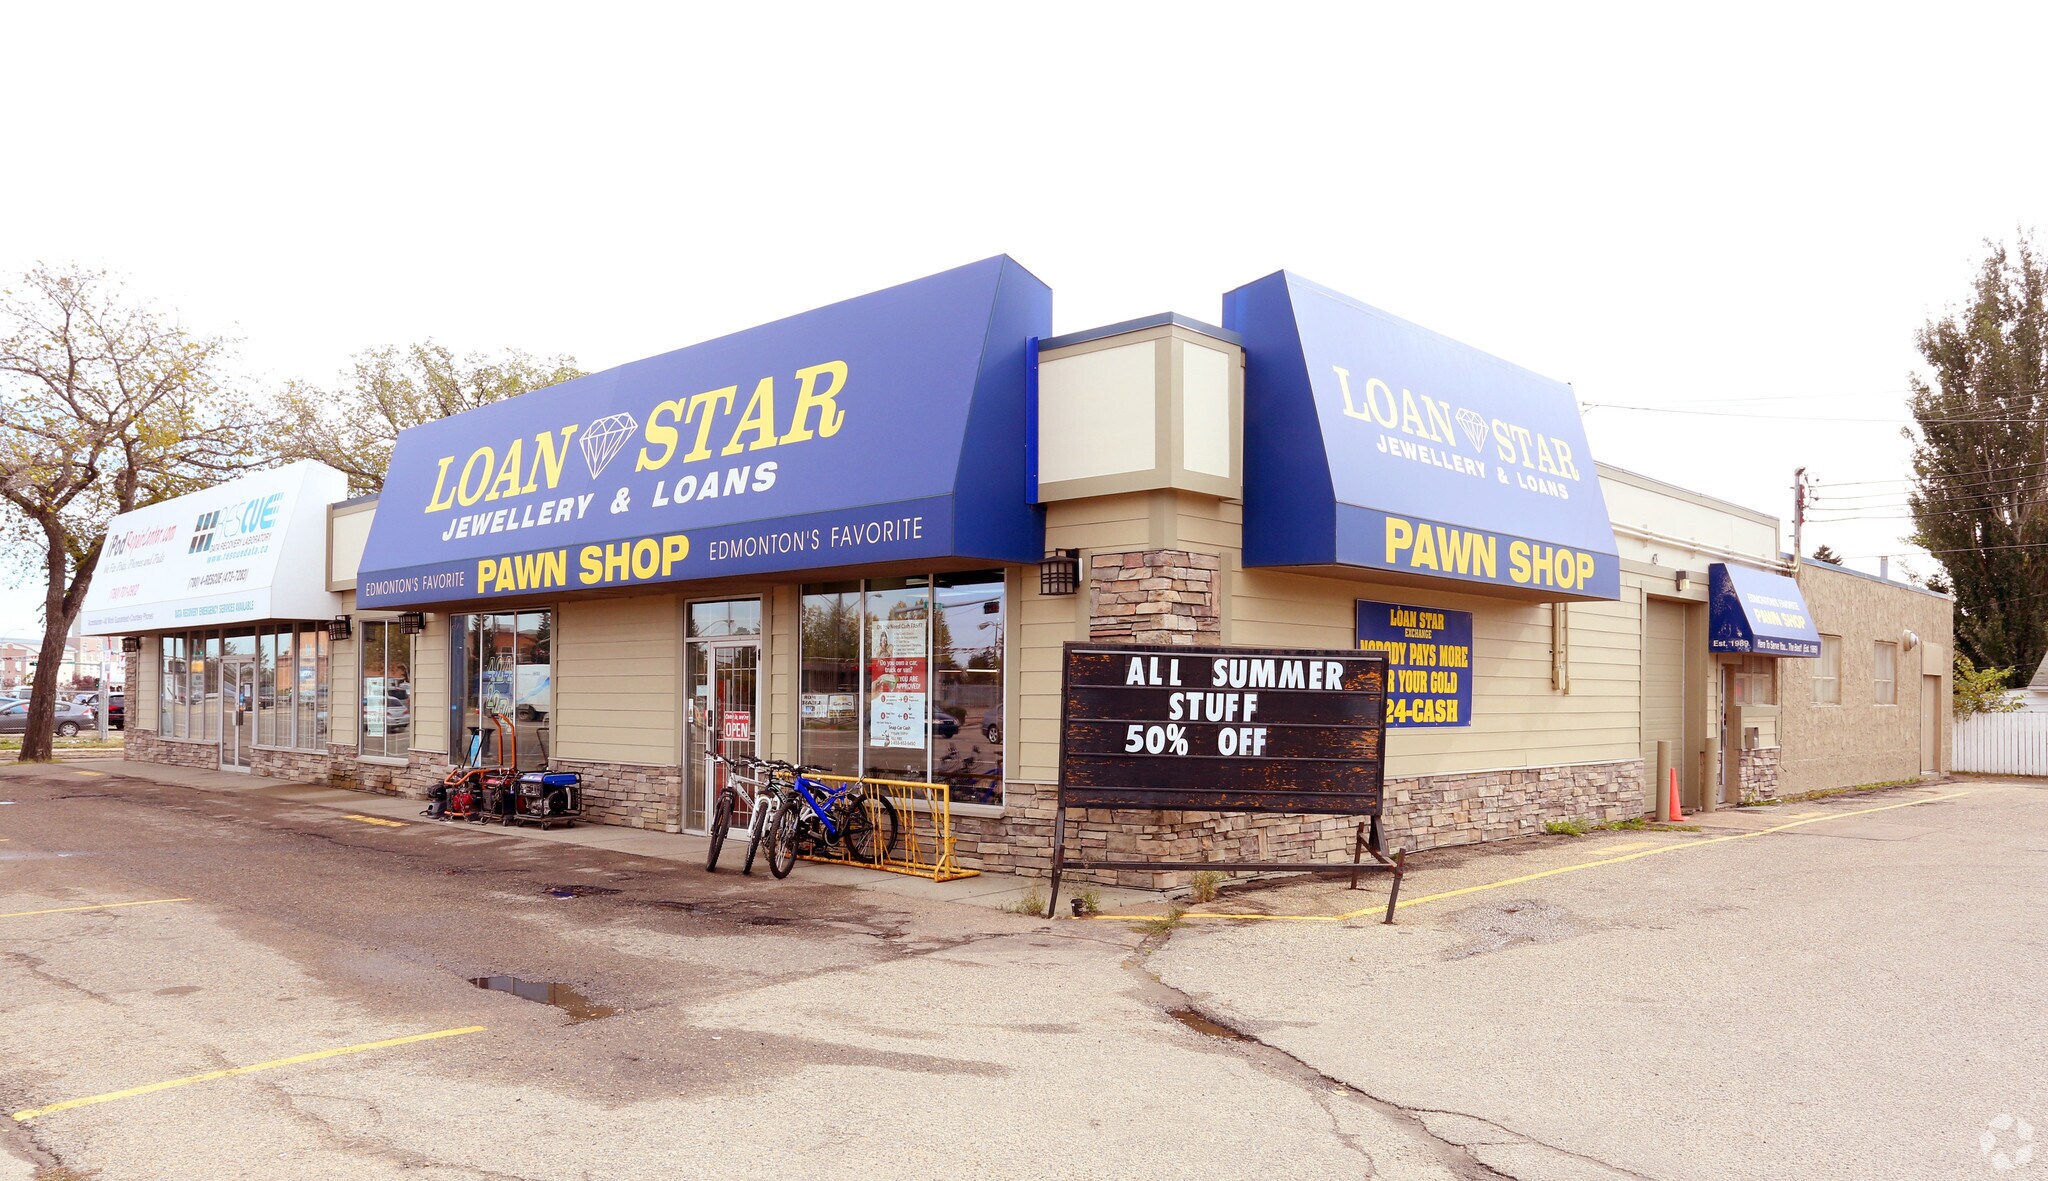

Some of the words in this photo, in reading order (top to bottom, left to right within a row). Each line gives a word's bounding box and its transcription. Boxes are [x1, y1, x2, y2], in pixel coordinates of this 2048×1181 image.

[424, 423, 579, 514] LOAN
[634, 360, 849, 472] STAR
[1332, 364, 1457, 447] LOAN
[1491, 418, 1581, 482] STAR
[1376, 433, 1486, 479] JEWELLERY
[1496, 466, 1510, 485] &
[1516, 471, 1569, 500] LOANS
[441, 492, 595, 541] JEWELLERY
[610, 486, 631, 514] &
[651, 461, 778, 508] LOANS
[708, 528, 820, 561] EDMONTON'S
[831, 516, 923, 548] FAVORITE
[1385, 516, 1497, 578] PAWN
[1509, 540, 1595, 591] SHOP
[477, 549, 567, 594] PAWN
[578, 534, 690, 586] SHOP
[365, 576, 419, 597] EDMONTON'S
[422, 571, 465, 590] FAVORITE
[1390, 608, 1417, 627] LOAN
[1419, 612, 1445, 630] STAR
[1404, 628, 1432, 639] EXCHANGE
[1753, 608, 1782, 626] PAWN
[1781, 613, 1806, 629] SHOP
[1409, 642, 1436, 667] PAYS
[1439, 644, 1468, 668] MORE
[1126, 656, 1182, 686] ALL
[1212, 658, 1344, 691] SUMMER
[1398, 670, 1428, 693] YOUR
[1430, 671, 1457, 694] GOLD
[1169, 692, 1258, 722] STUFF
[726, 722, 748, 738] OPEN
[1124, 723, 1189, 757] 50%
[1217, 727, 1267, 757] OFF
